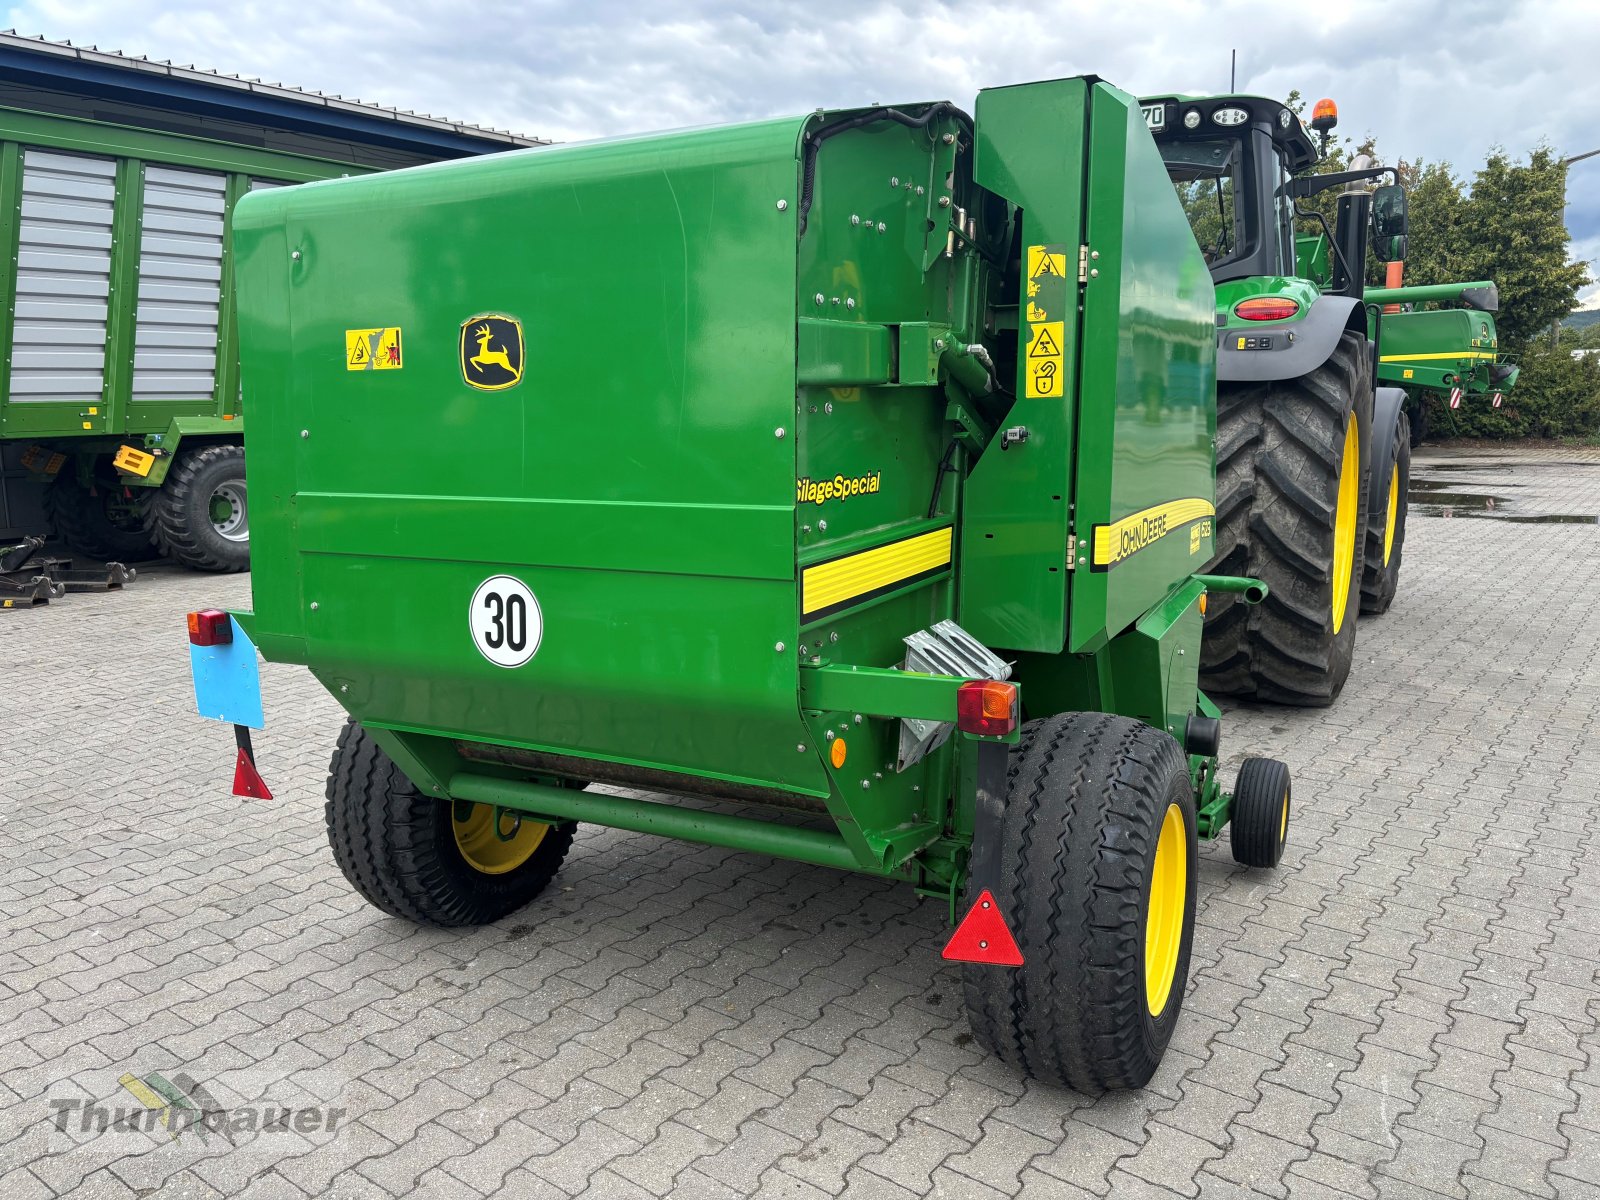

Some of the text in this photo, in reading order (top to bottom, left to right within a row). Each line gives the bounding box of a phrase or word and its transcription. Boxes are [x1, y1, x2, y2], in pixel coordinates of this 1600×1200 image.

[1117, 524, 1142, 558] JOHN
[1141, 514, 1167, 546] DEERE
[484, 591, 527, 652] 30
